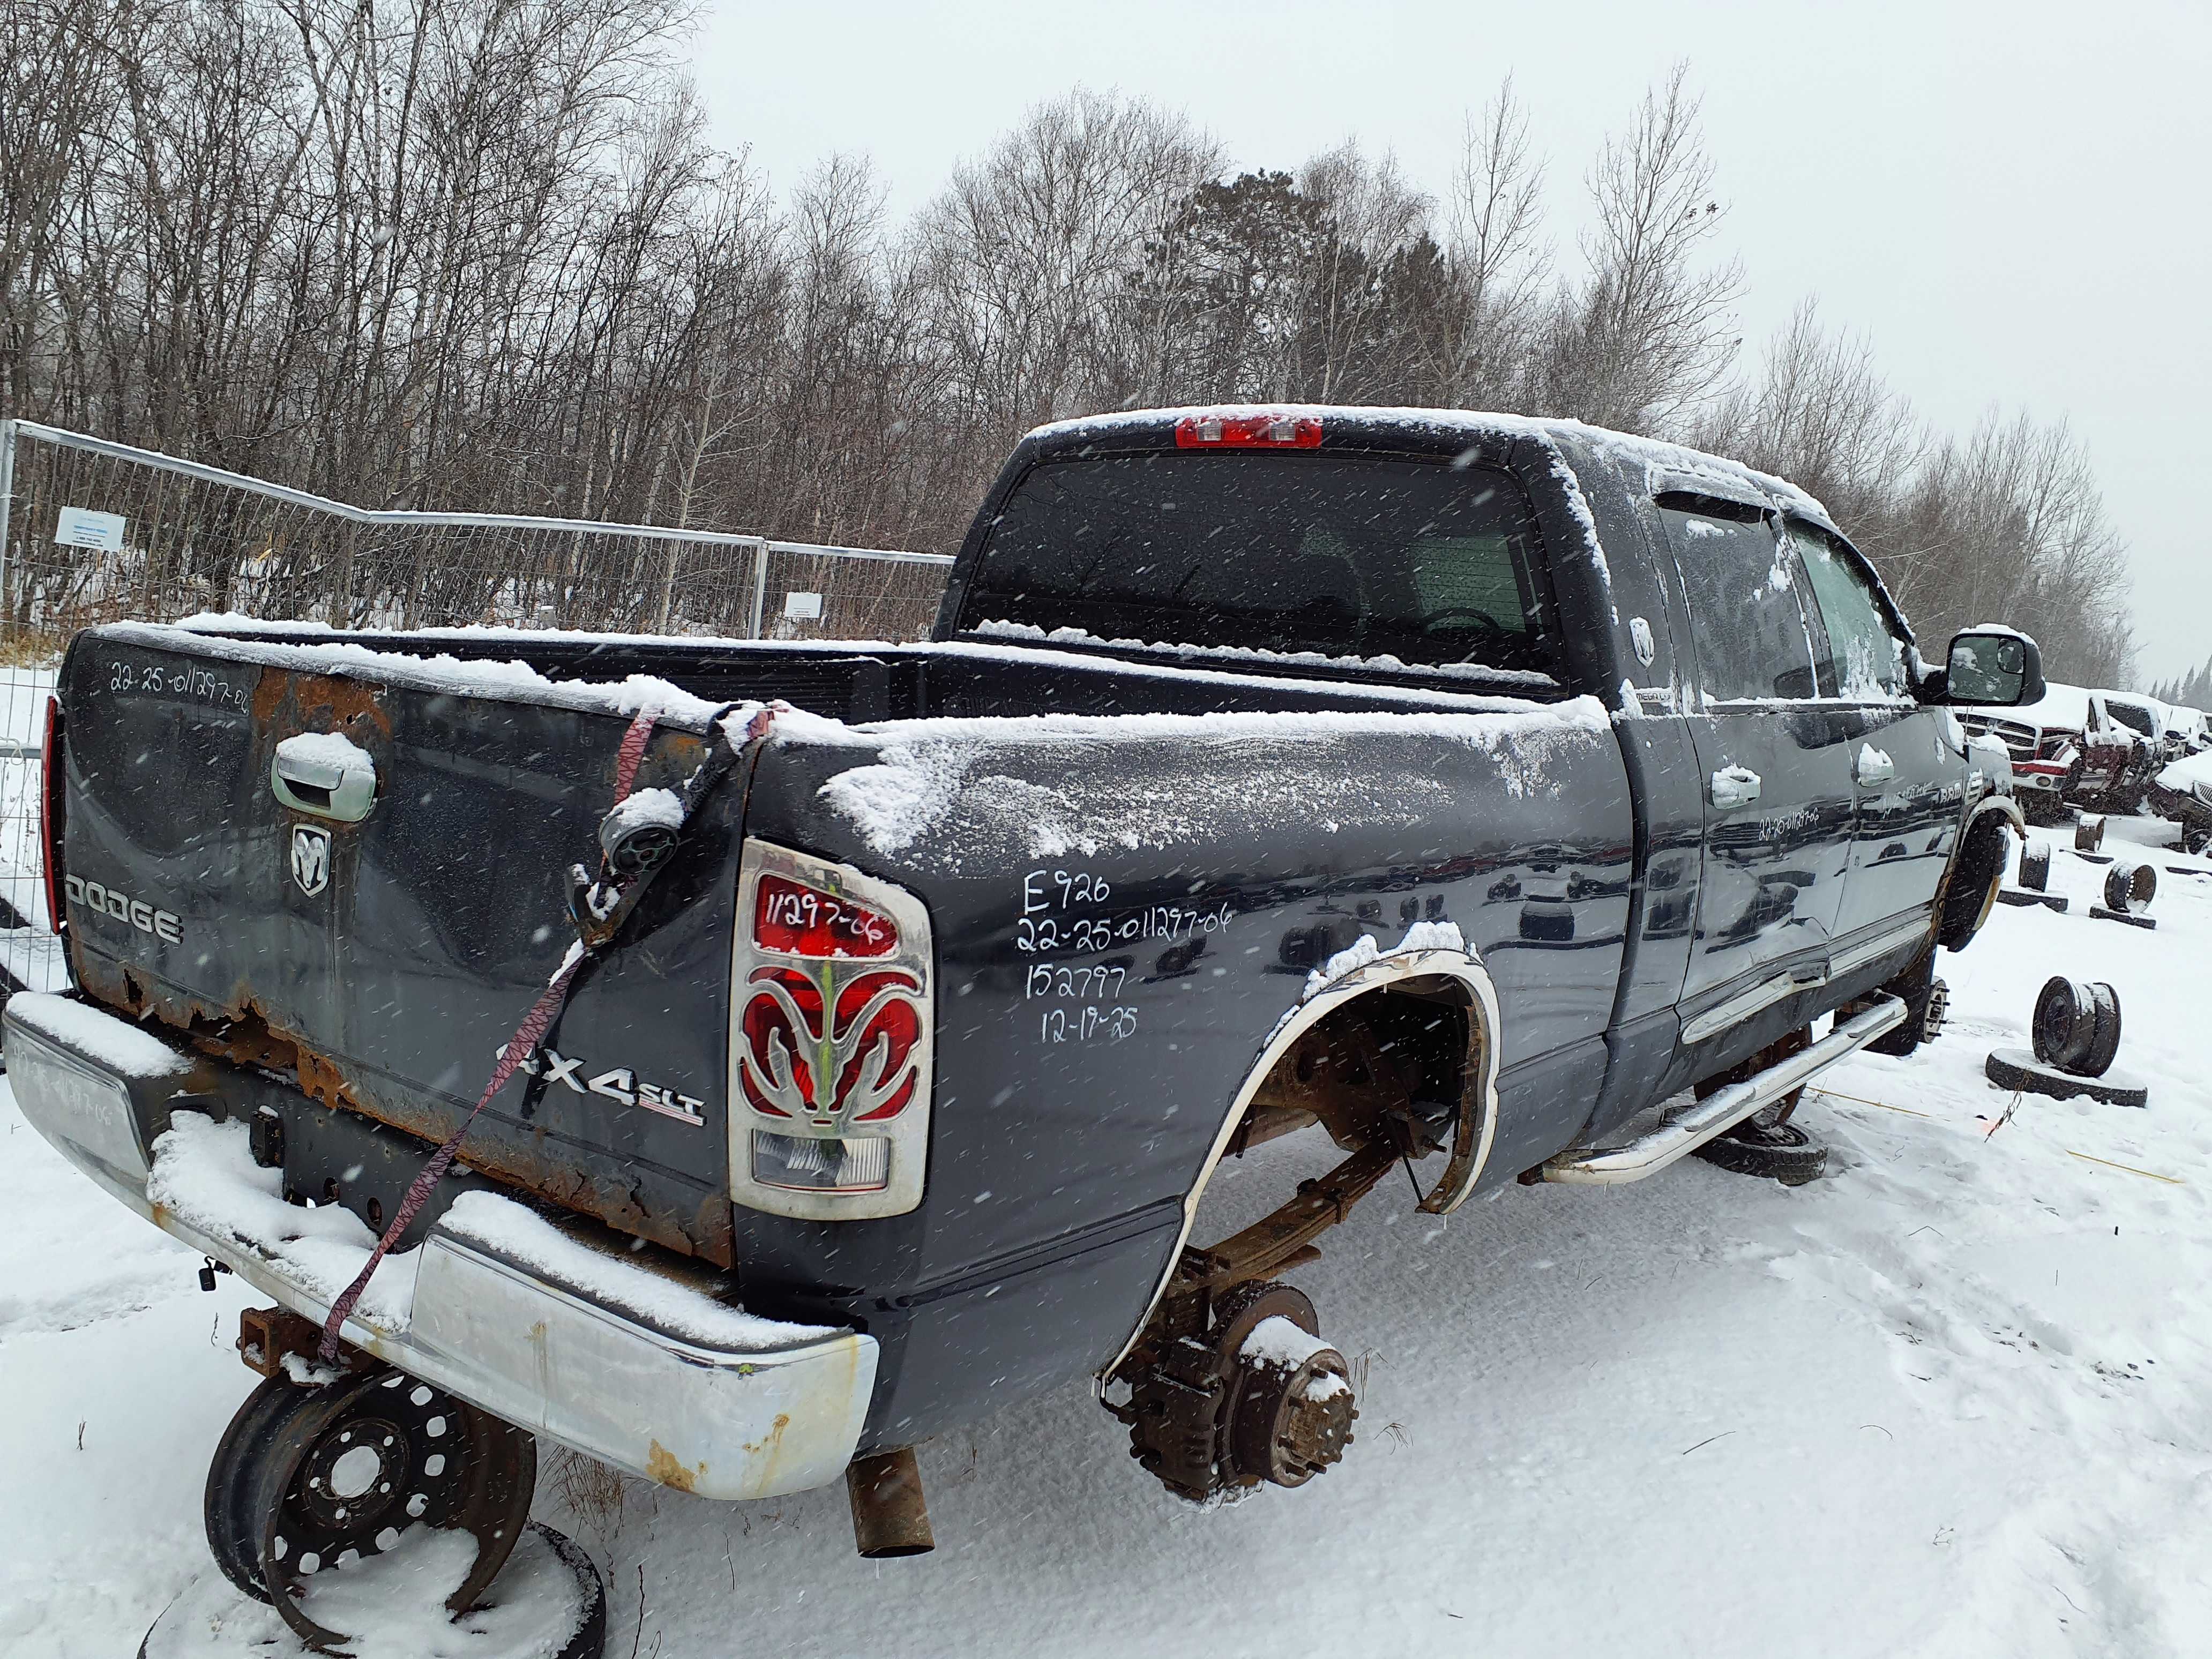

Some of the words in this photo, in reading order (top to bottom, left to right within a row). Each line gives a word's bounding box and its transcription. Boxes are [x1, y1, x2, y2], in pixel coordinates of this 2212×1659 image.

[1939, 782, 1962, 804] RAM
[1759, 807, 1819, 841] 22-25-011297-06
[65, 873, 184, 944] DODGE
[1023, 870, 1110, 915] E926
[765, 893, 884, 945] 11297-06
[1018, 901, 1233, 952] 22-25-011297-06
[1026, 964, 1126, 1000] 152797
[1042, 1006, 1139, 1043] 12-19-25
[639, 1082, 707, 1115] SLT
